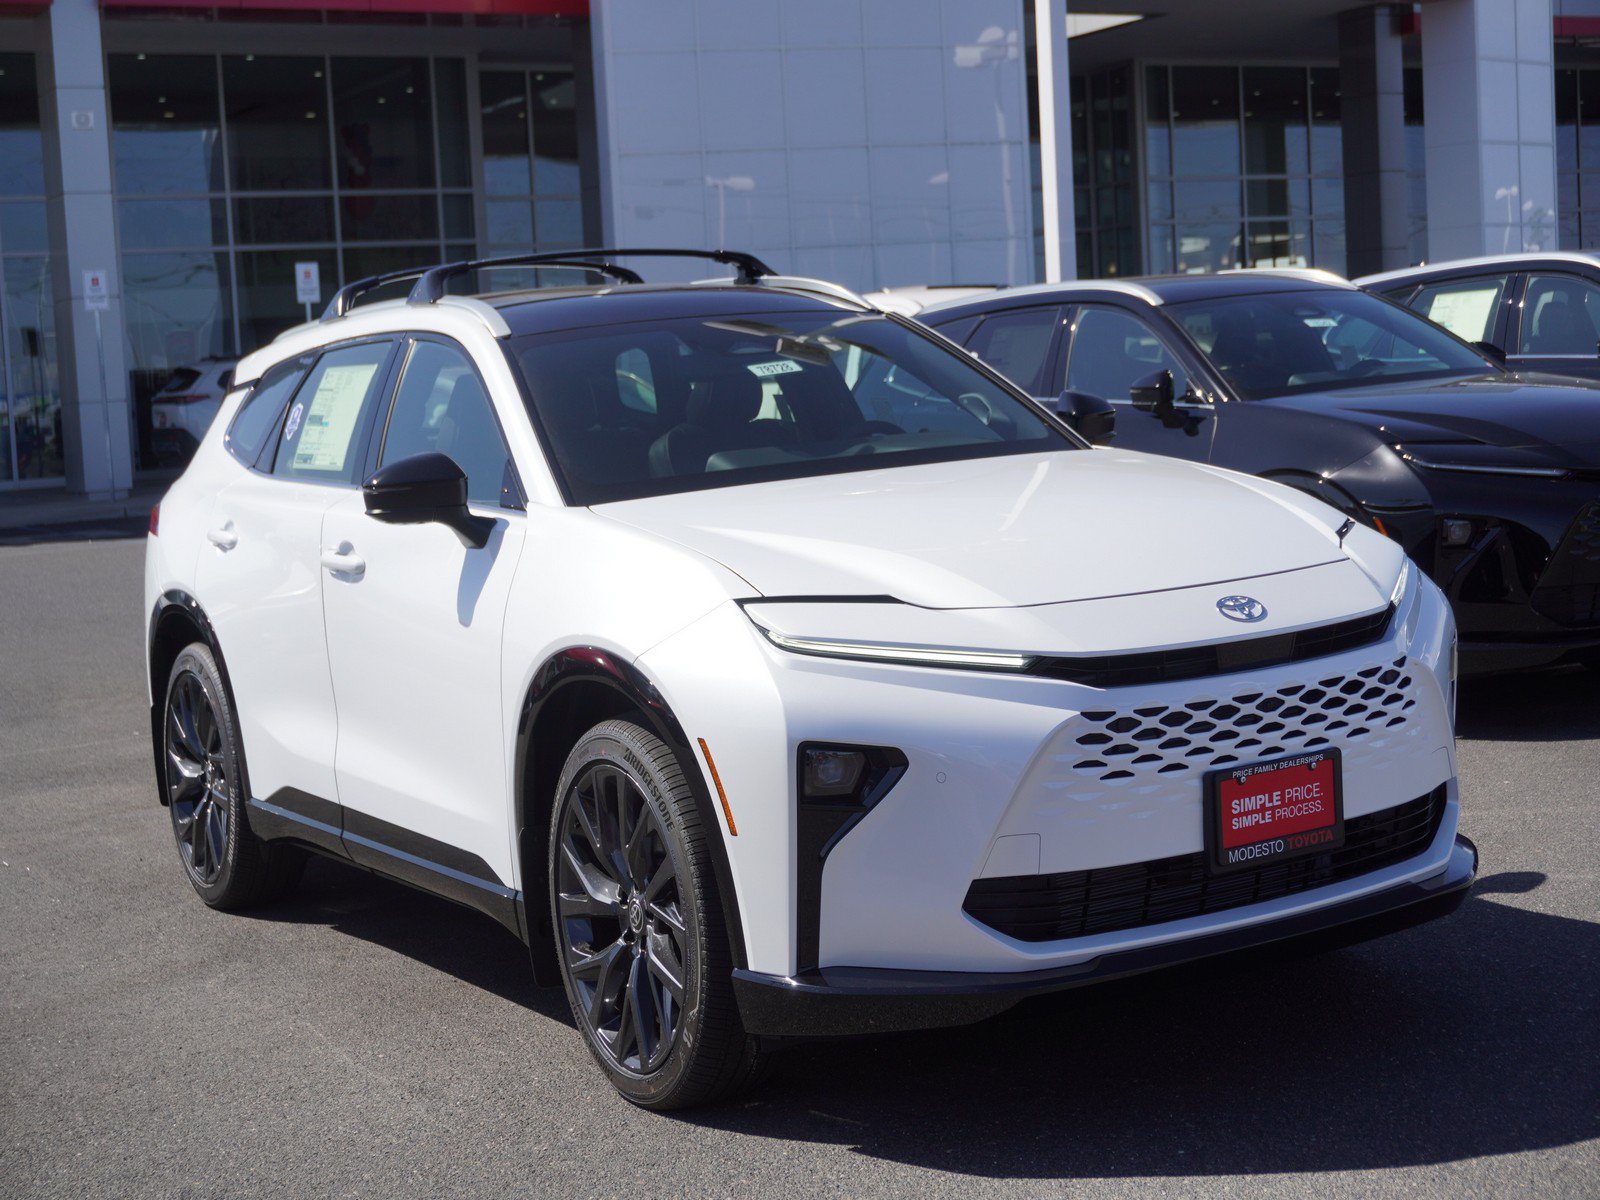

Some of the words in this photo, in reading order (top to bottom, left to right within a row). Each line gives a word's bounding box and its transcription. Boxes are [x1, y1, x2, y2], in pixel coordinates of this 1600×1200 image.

[1232, 768, 1253, 779] PRICE
[1254, 763, 1279, 775] FAMILY
[1279, 754, 1324, 769] DEALERSHIPS
[622, 748, 676, 833] BRIDGESTONE
[1231, 791, 1282, 815] SIMPLE
[1285, 782, 1324, 803] PRICE.
[1231, 811, 1272, 830] SIMPLE
[1275, 800, 1325, 821] PROCESS.
[1228, 839, 1285, 864] MODESTO
[1287, 829, 1334, 849] TOYOTA
